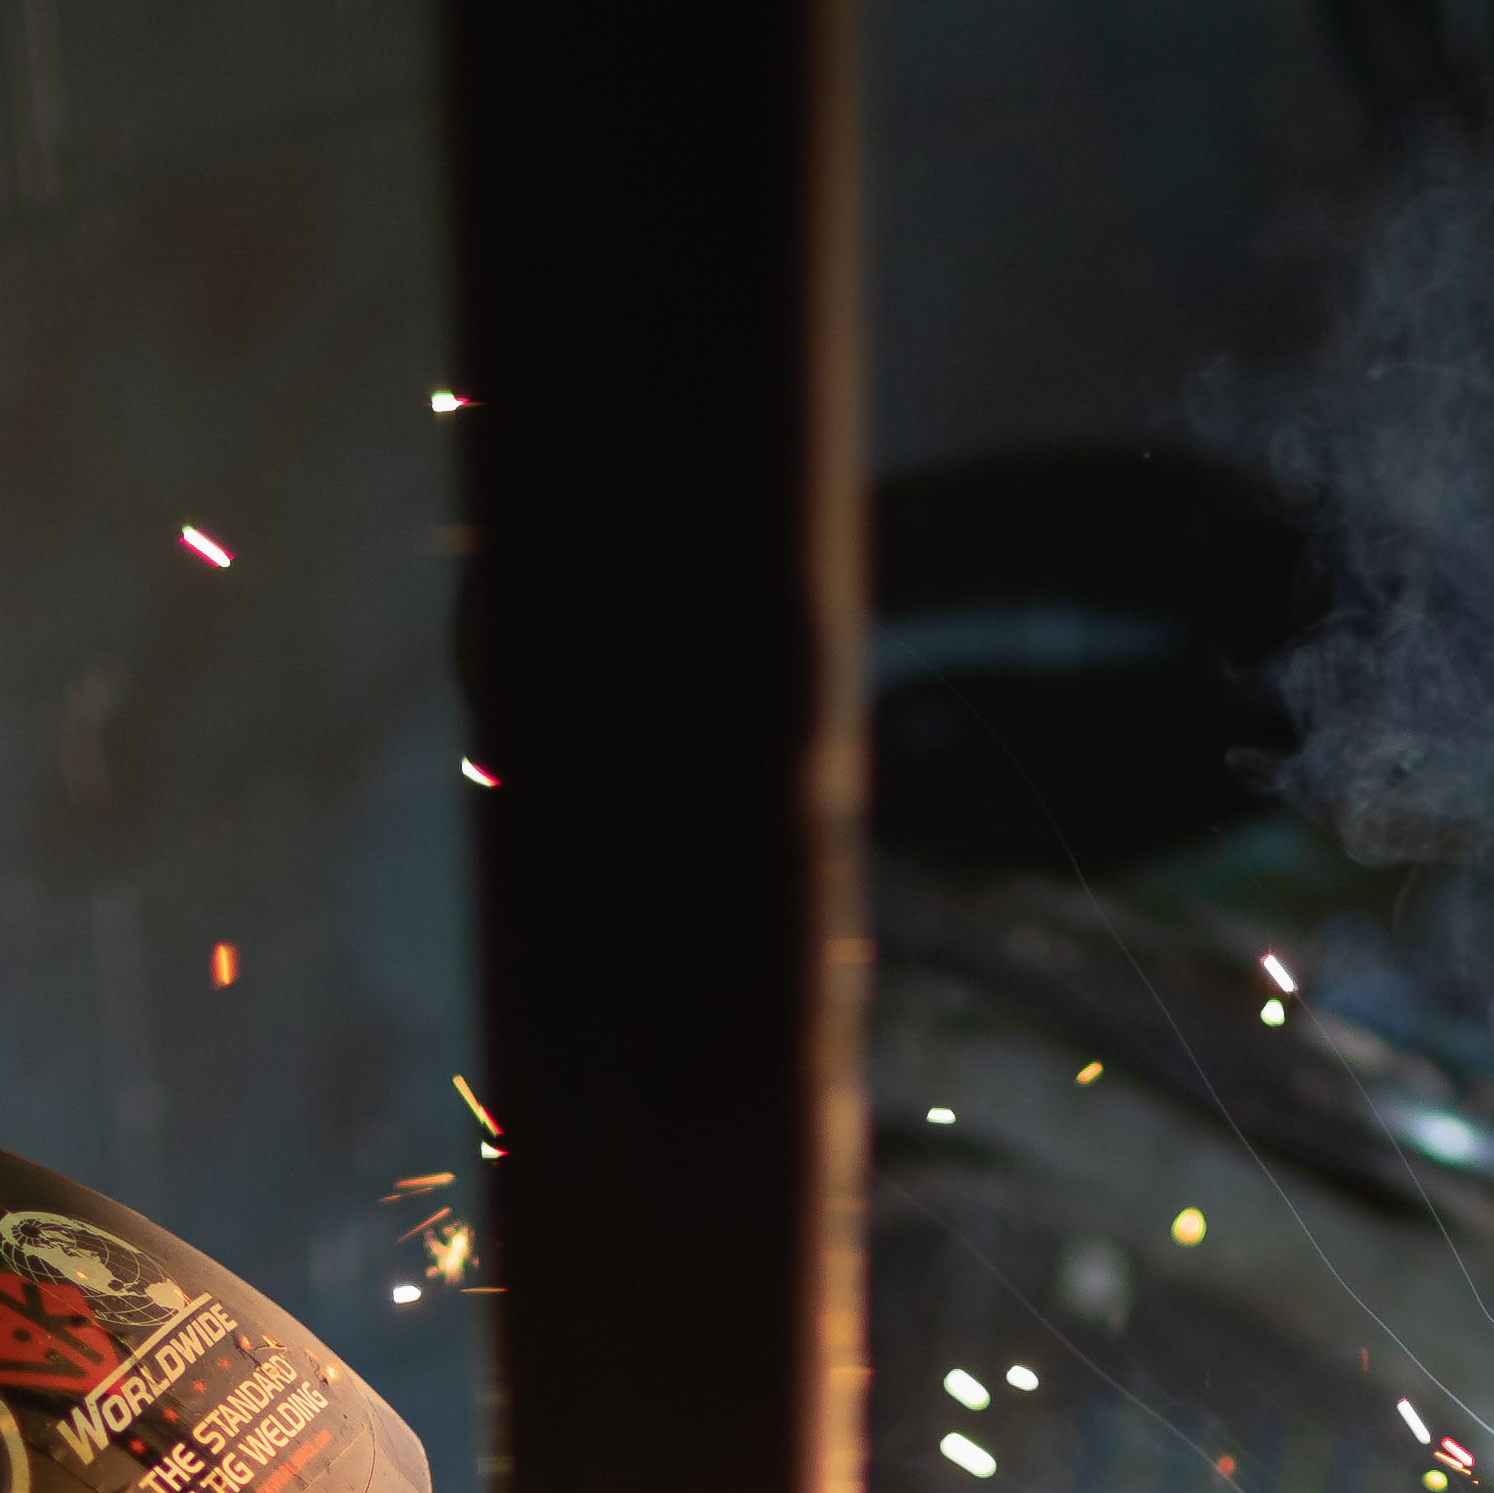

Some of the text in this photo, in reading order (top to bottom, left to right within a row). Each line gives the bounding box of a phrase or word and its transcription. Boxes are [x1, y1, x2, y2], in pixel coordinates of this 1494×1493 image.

[55, 1300, 239, 1466] WORLDWIDE
[194, 1354, 298, 1455] STANDARD
[240, 1381, 330, 1470] WELDING
